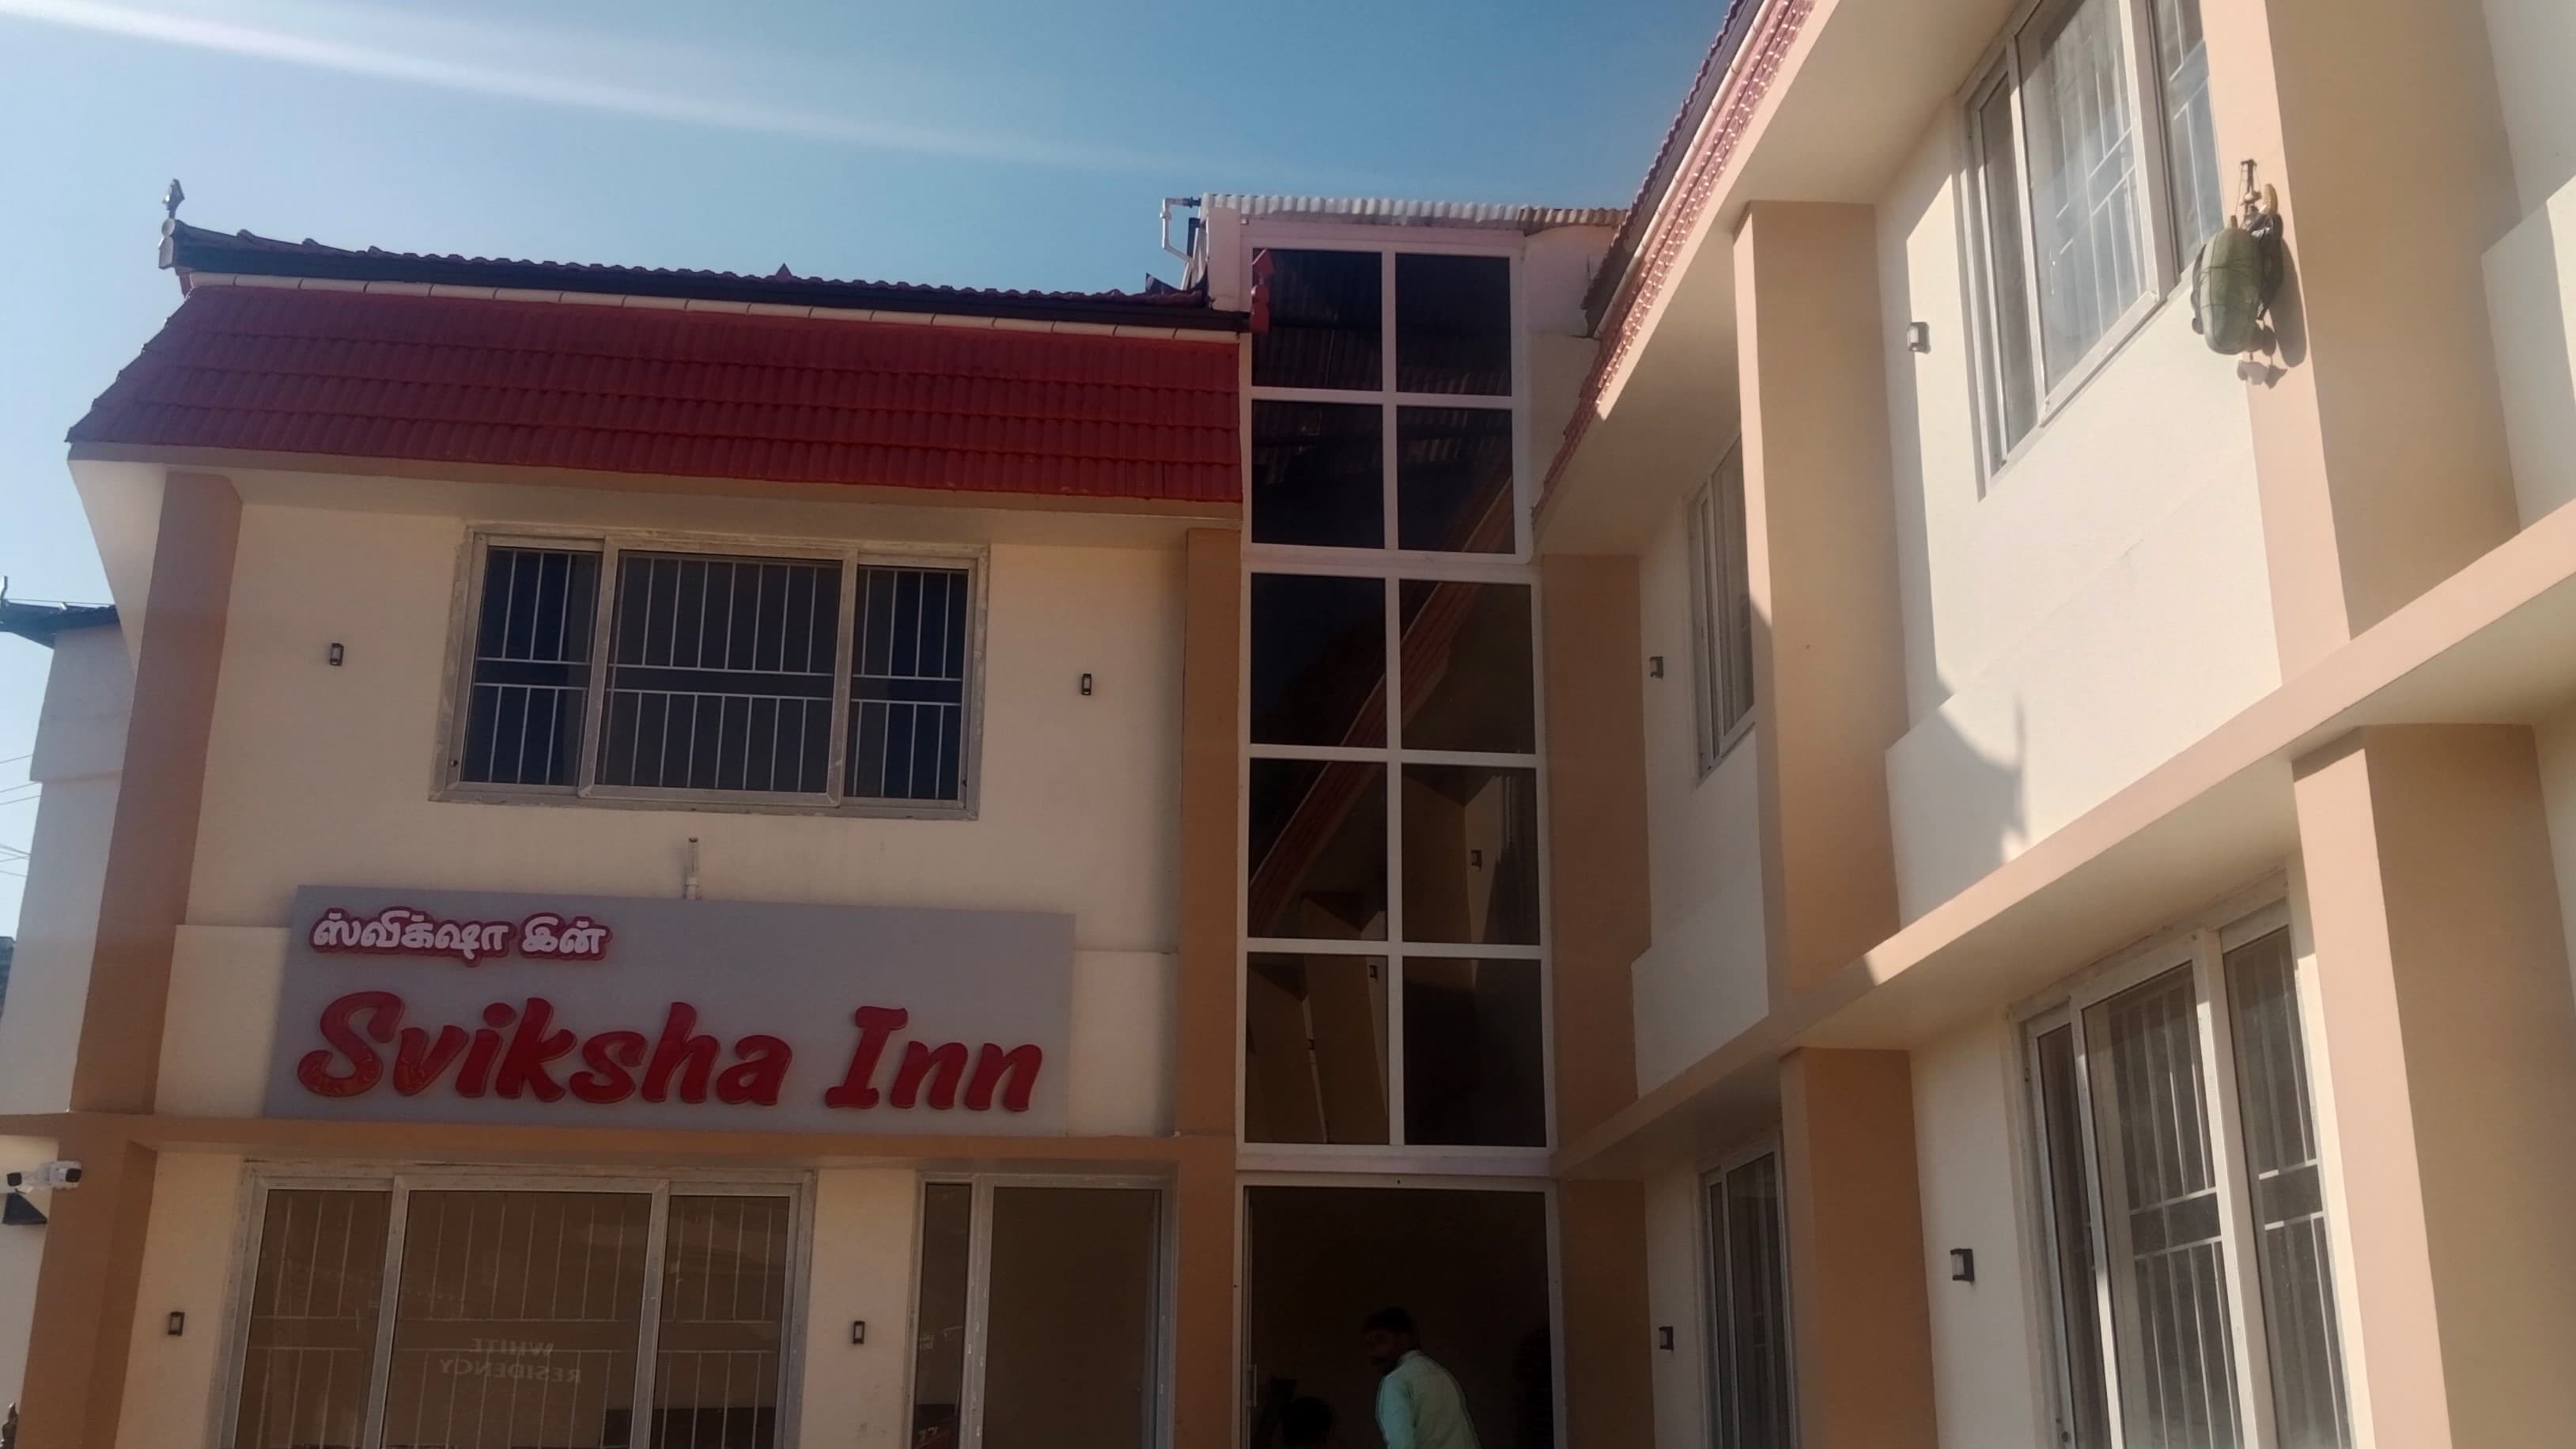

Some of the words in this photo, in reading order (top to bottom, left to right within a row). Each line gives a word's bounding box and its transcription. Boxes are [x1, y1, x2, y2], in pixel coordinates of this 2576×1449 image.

[520, 913, 609, 959] இன்
[297, 991, 792, 1107] Sviksha
[824, 1005, 1044, 1112] Inn
